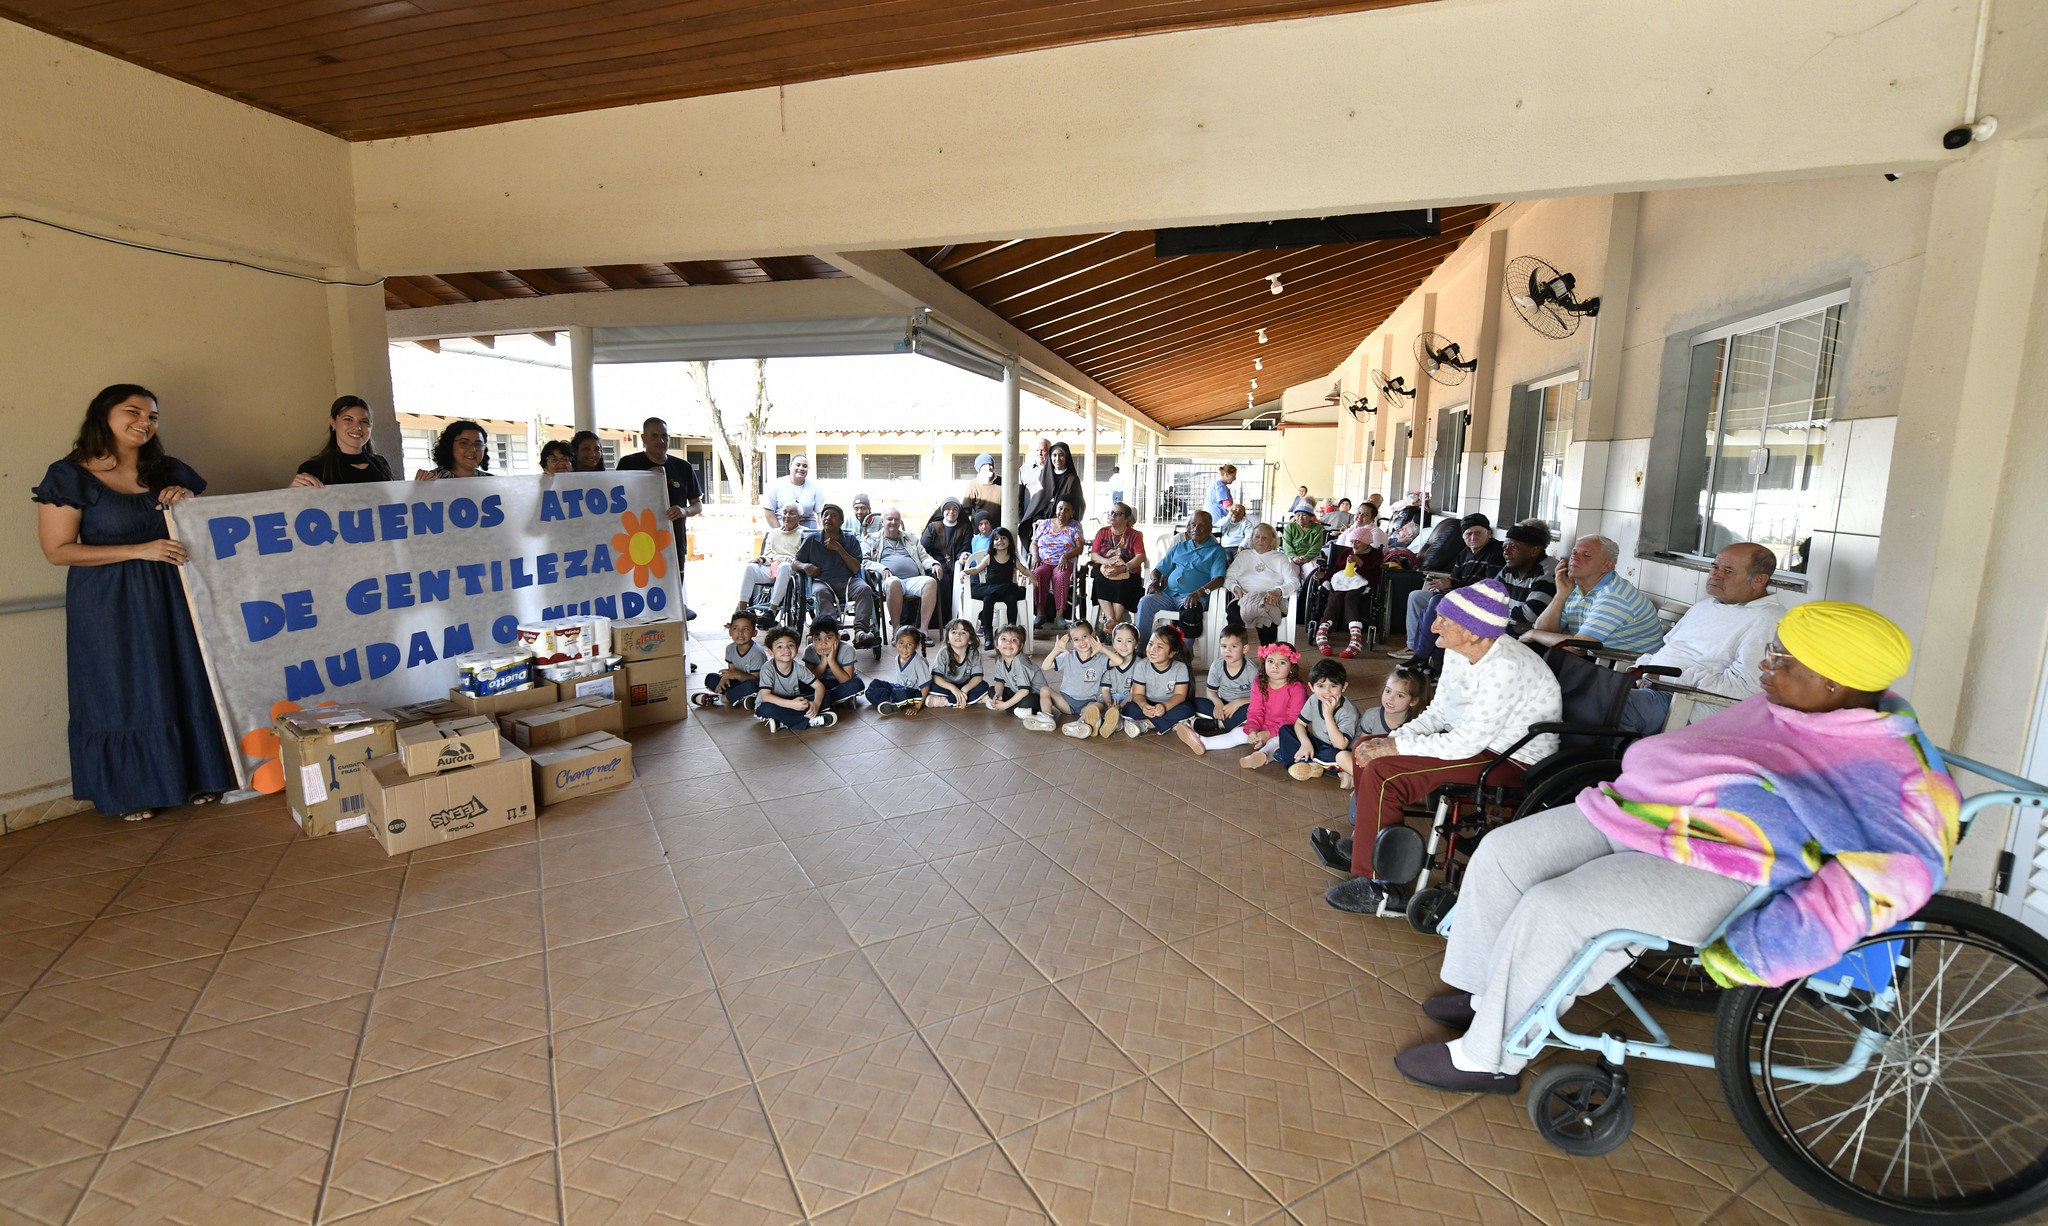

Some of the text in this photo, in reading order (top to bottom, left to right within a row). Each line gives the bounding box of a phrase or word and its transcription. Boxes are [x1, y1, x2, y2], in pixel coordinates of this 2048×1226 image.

[209, 486, 628, 560] PEQUENOS ATOS
[241, 543, 615, 642] DE GENTILEZA
[285, 586, 667, 701] MUDAM O MUNDO
[488, 670, 527, 689] Duetto
[436, 752, 475, 767] Aurora
[429, 796, 488, 829] TEENS
